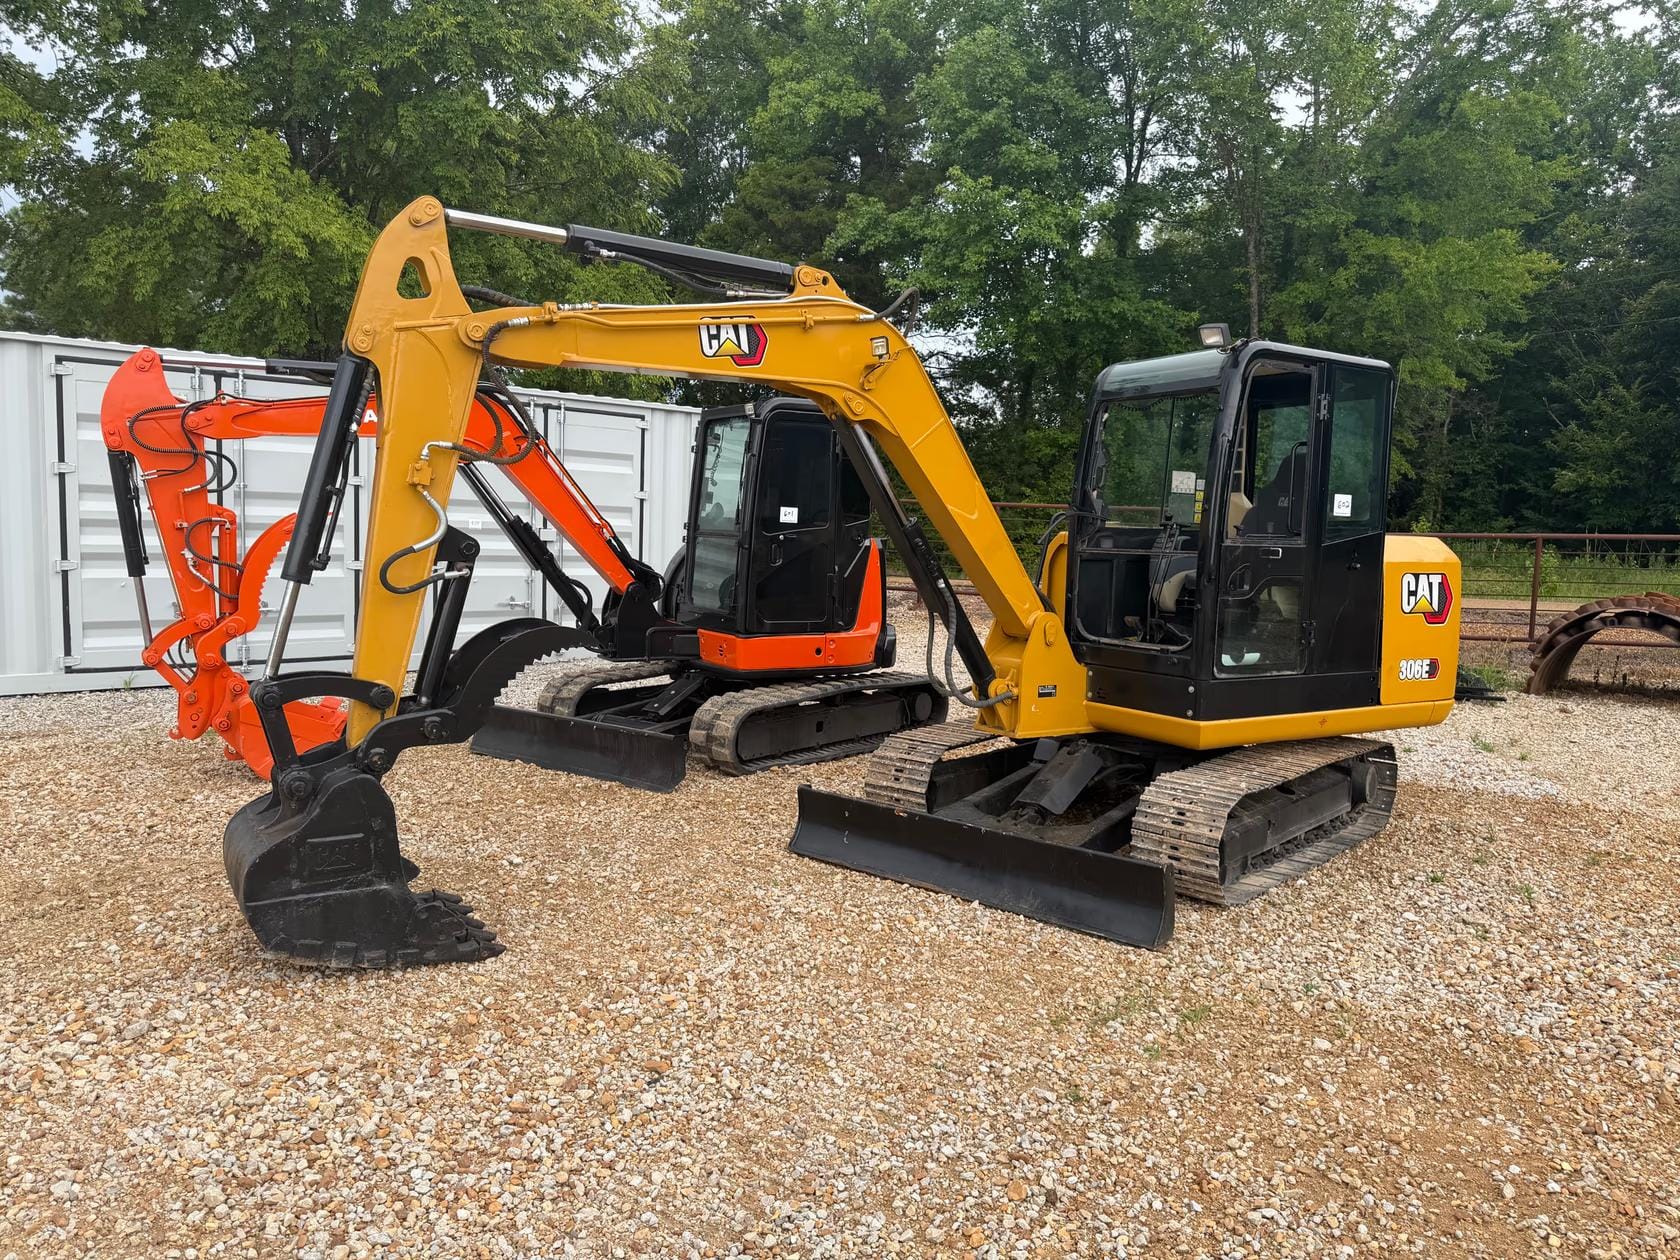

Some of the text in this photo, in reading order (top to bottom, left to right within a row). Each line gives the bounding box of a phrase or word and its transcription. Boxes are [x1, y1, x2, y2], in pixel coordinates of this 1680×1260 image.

[699, 317, 751, 356] CAT
[1402, 573, 1442, 613] CAT
[1399, 659, 1431, 680] 306E
